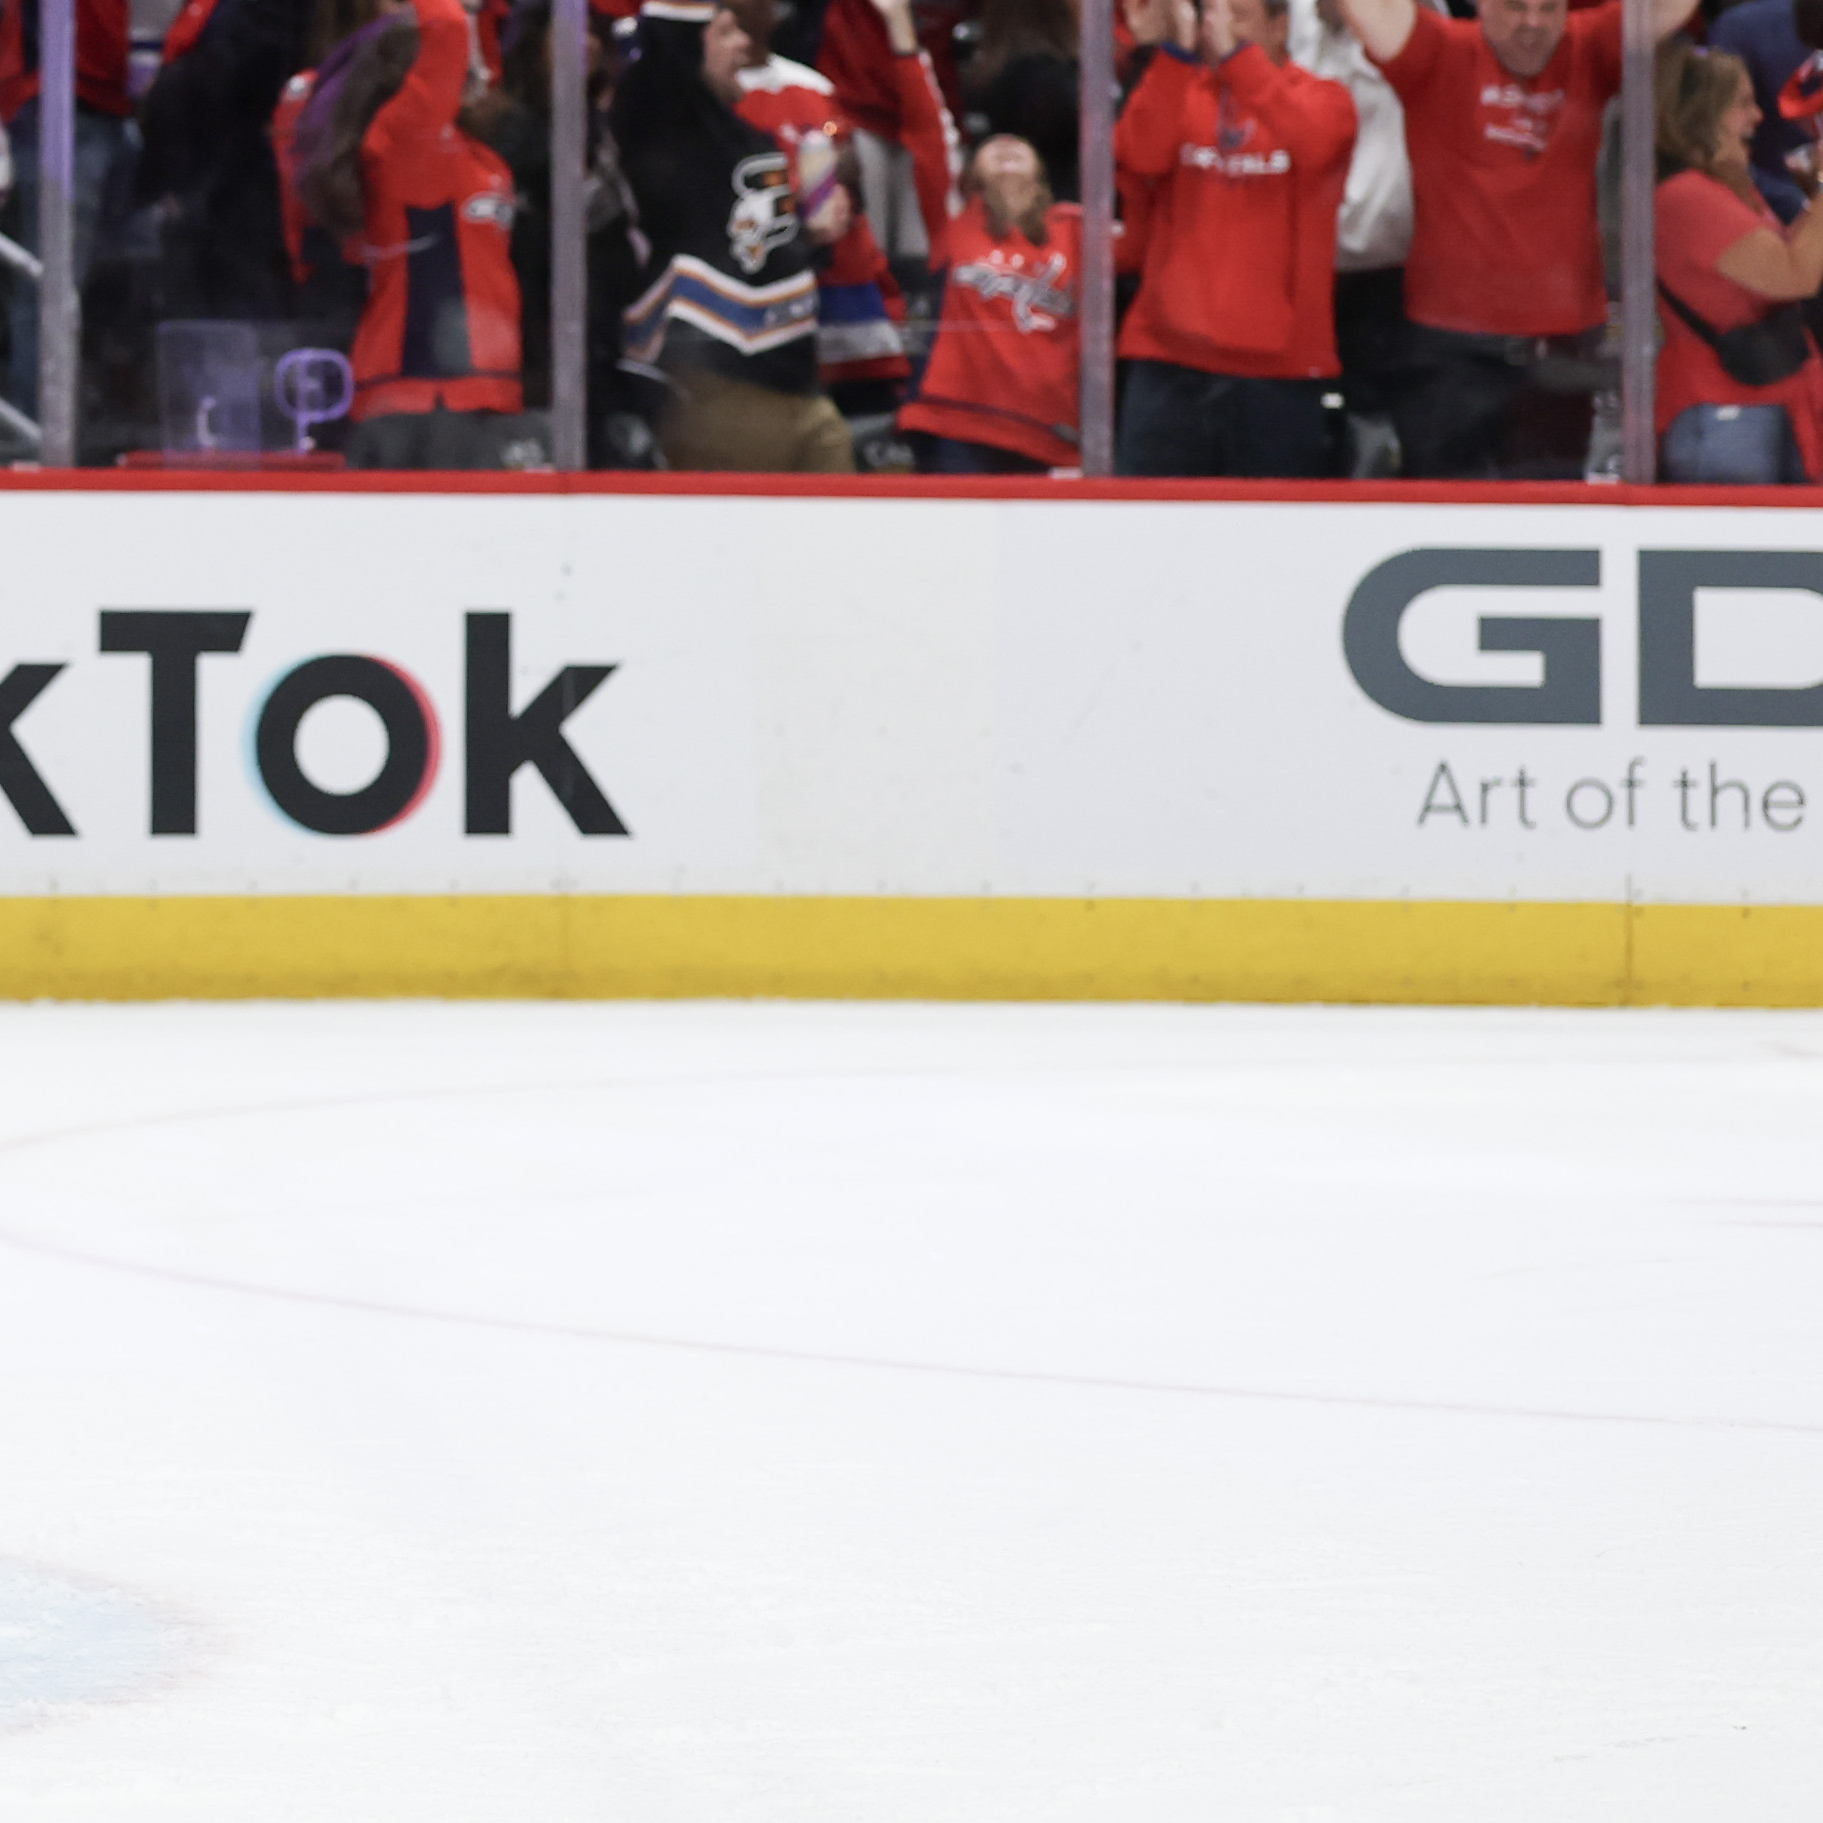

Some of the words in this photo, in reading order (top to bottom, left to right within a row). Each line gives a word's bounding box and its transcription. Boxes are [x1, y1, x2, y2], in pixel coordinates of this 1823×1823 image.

[1416, 756, 1538, 829] Art
[1564, 756, 1647, 831] of
[1675, 758, 1809, 832] the
